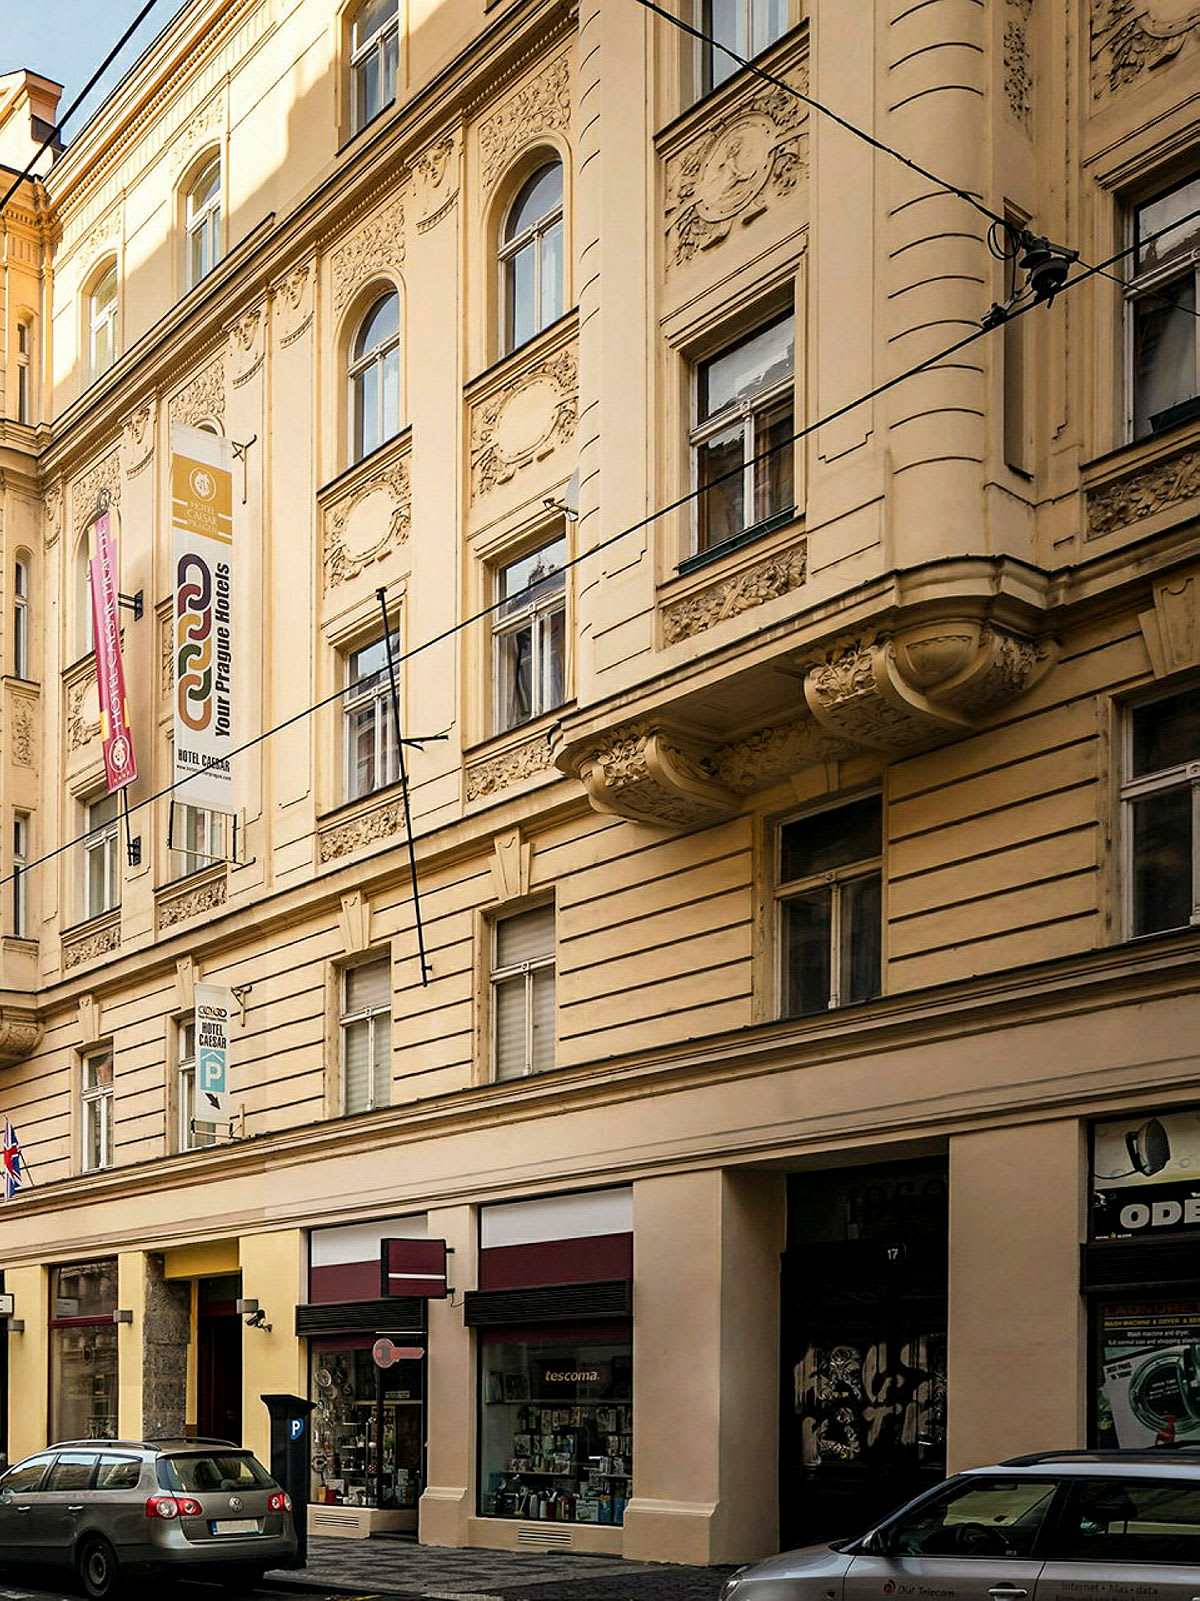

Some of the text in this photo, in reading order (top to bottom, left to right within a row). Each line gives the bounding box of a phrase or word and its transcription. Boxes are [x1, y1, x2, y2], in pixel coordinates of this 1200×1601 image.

[215, 562, 232, 737] Your Prague Hotels
[178, 748, 200, 765] HOTEL
[201, 1022, 224, 1037] HOTEL
[198, 1033, 227, 1050] CAESAR
[205, 1061, 222, 1088] P
[887, 1248, 899, 1260] 17
[292, 1419, 300, 1436] P
